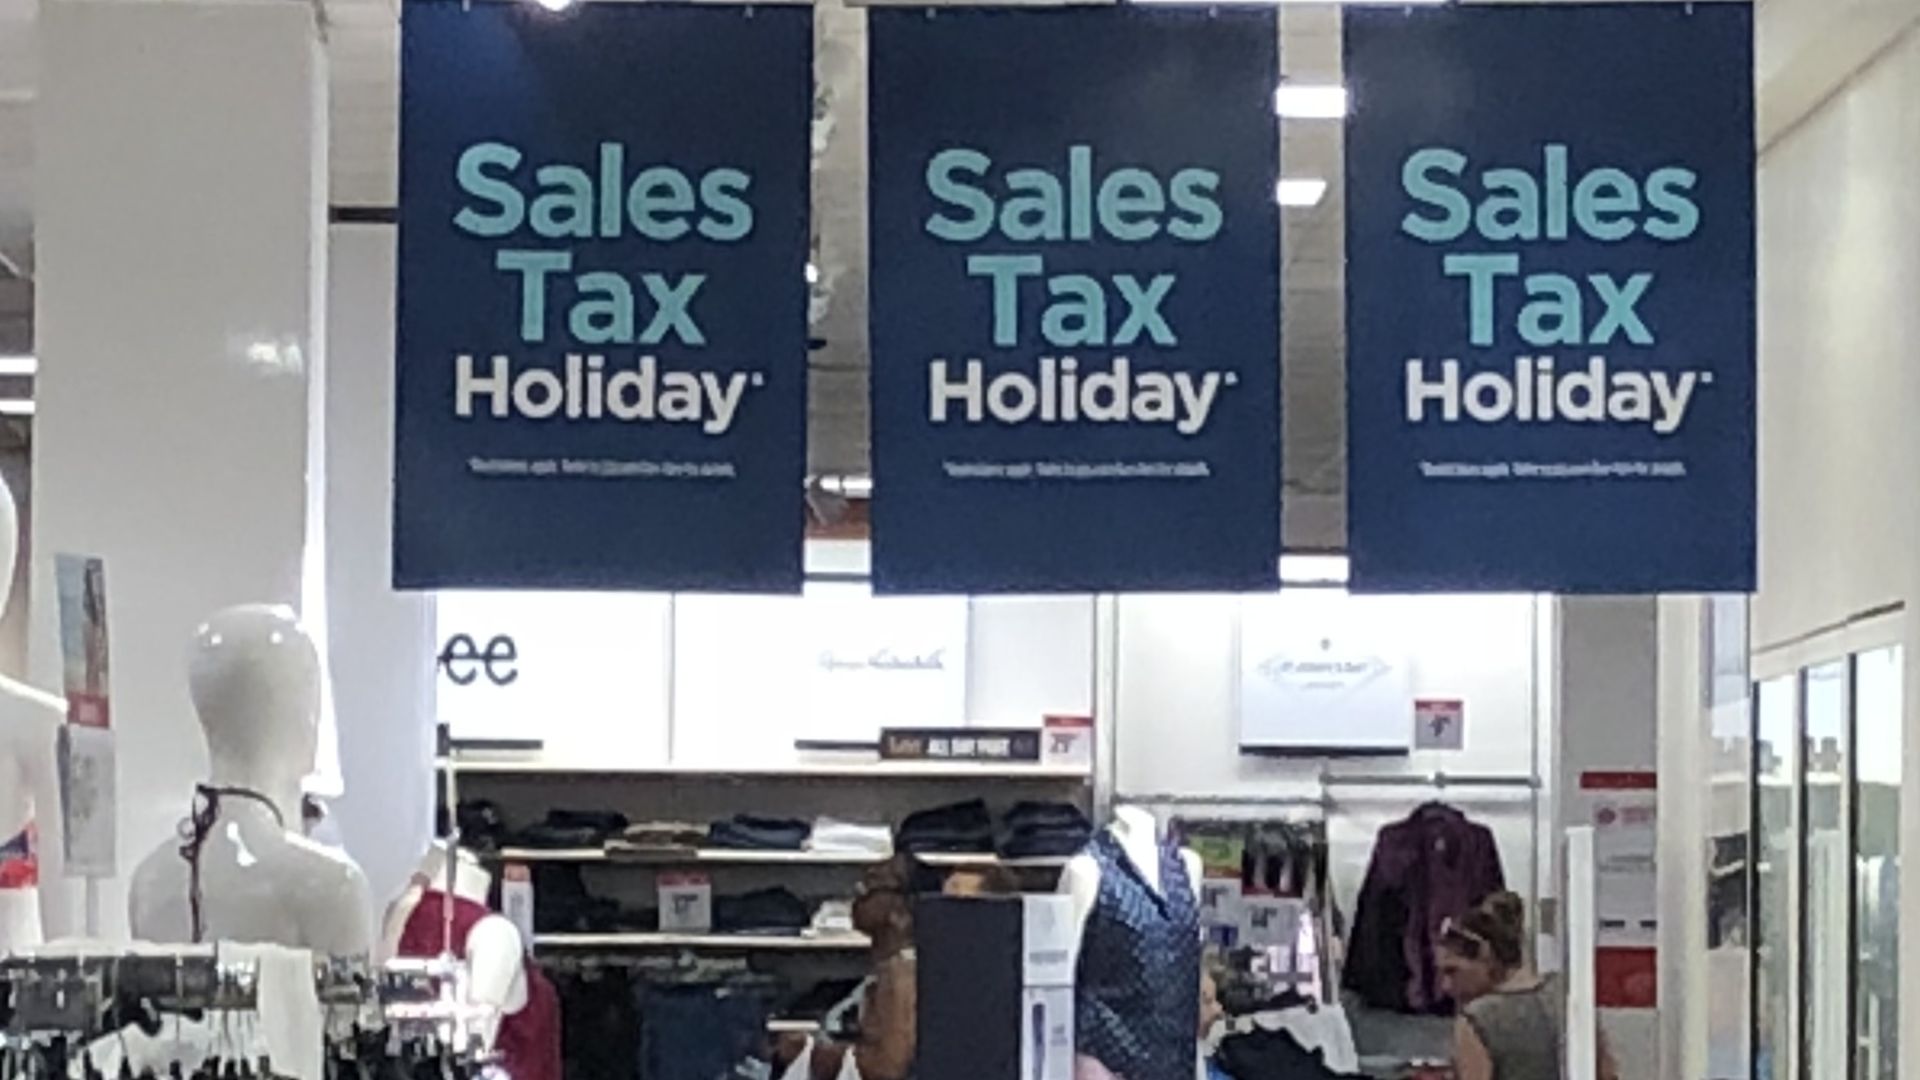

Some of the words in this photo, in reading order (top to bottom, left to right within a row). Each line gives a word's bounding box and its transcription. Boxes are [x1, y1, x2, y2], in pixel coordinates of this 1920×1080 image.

[454, 143, 752, 240] Sales
[926, 146, 1223, 241] Sales
[1401, 144, 1698, 241] Sales
[496, 250, 706, 345] Tax
[968, 255, 1176, 347] Tax
[1444, 253, 1654, 347] Tax
[437, 633, 518, 685] ee
